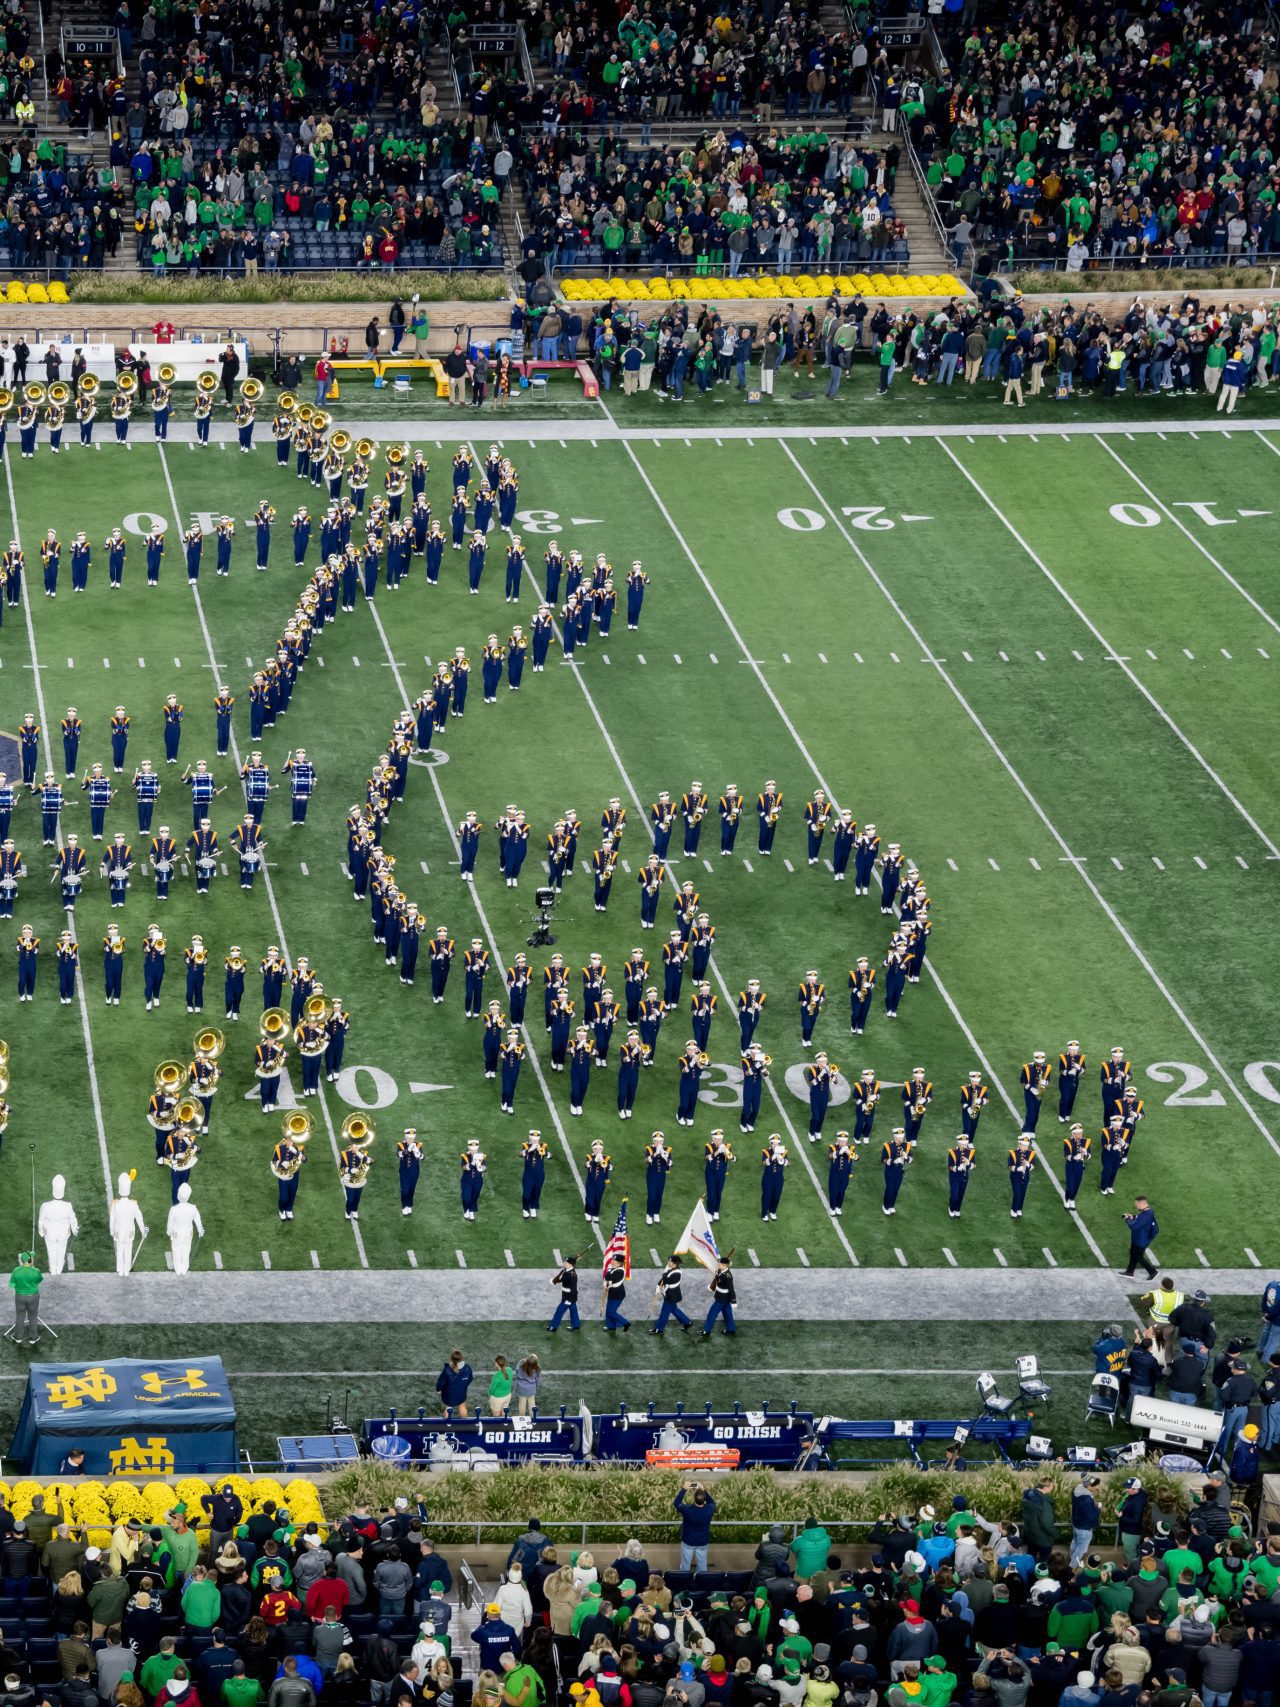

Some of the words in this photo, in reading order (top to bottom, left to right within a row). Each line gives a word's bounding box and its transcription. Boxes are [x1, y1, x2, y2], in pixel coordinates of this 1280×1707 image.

[884, 35, 892, 44] 12
[902, 34, 911, 44] 13
[76, 43, 85, 52] 10
[96, 43, 103, 52] 11
[479, 42, 486, 50] 11
[496, 42, 504, 50] 12
[749, 392, 760, 400] 20
[1058, 388, 1067, 396] 10
[777, 506, 895, 531] 20
[1108, 501, 1237, 528] 10
[134, 1394, 170, 1402] UNDER
[1160, 1416, 1179, 1425] Rental
[485, 1432, 504, 1443] GO
[508, 1431, 552, 1443] IRISH
[714, 1427, 734, 1439] GO
[738, 1426, 781, 1438] IRISH
[274, 1600, 286, 1617] 2
[425, 1658, 432, 1672] 4
